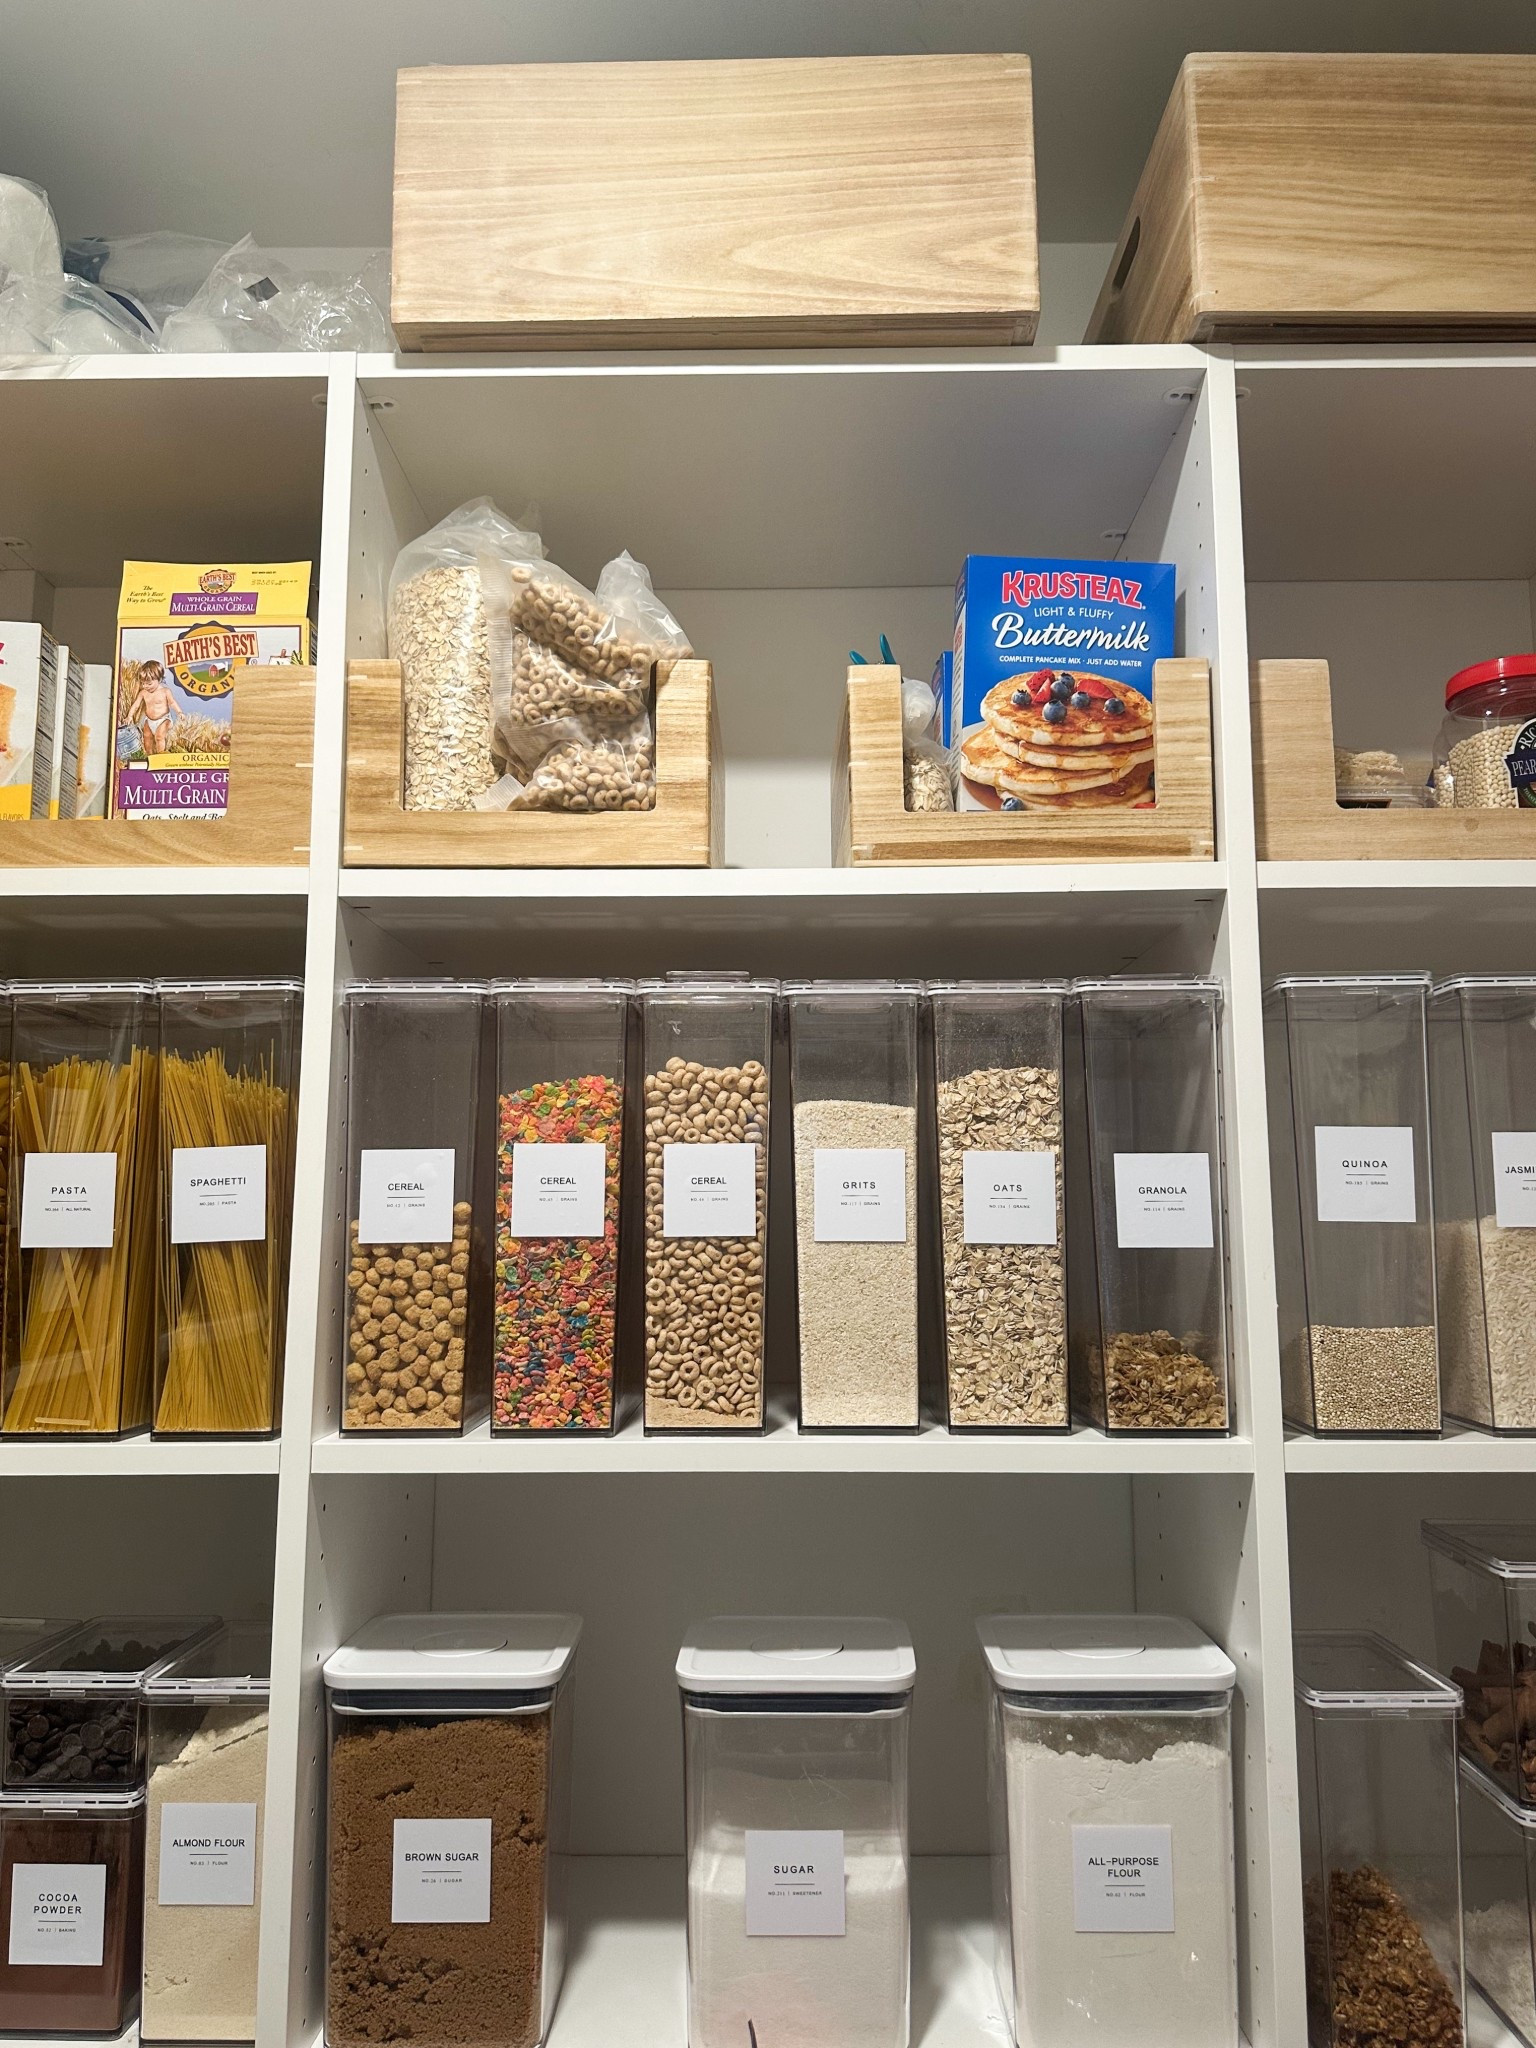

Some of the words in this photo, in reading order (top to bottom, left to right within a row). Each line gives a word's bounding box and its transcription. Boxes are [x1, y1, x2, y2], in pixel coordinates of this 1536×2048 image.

[222, 573, 235, 581] BEST
[1001, 570, 1142, 610] KRUSTEAZ
[171, 602, 226, 613] MULTI-GRAIN
[225, 601, 256, 612] CEREAL
[1033, 606, 1065, 618] LIGHT
[1067, 607, 1076, 617] &
[1078, 608, 1114, 621] FLUFFY
[991, 611, 1150, 652] Buttermilk
[165, 636, 221, 666] EARTH'S
[222, 633, 256, 659] BEST
[999, 655, 1034, 663] COMPLETE
[1035, 656, 1067, 665] PANCAKE
[1067, 656, 1081, 665] MIX
[1085, 658, 1103, 666] JUST
[1103, 658, 1119, 666] ADD
[1119, 659, 1142, 667] WATER
[182, 754, 230, 762] ORGANIC
[151, 772, 208, 784] WHOLE
[123, 784, 227, 805] MULTI-GRAIN
[1341, 1160, 1388, 1169] QUINOA
[190, 1176, 247, 1187] SPAGHETTI
[540, 1176, 577, 1185] CEREAL
[690, 1176, 727, 1185] CEREAL
[387, 1182, 425, 1191] CEREAL
[842, 1181, 876, 1190] GRITS
[993, 1184, 1023, 1192] OATS
[51, 1186, 87, 1195] PASTA
[1138, 1186, 1188, 1195] GRANOLA
[172, 1838, 212, 1848] ALMOND
[214, 1838, 246, 1848] FLOUR
[405, 1852, 442, 1862] BROWN
[444, 1852, 479, 1862] SUGAR
[1088, 1857, 1159, 1866] ALL-PURPOSE
[773, 1865, 815, 1874] SUGAR
[1107, 1868, 1141, 1878] FLOUR
[38, 1893, 78, 1902] COCOA
[33, 1905, 82, 1914] POWDER
